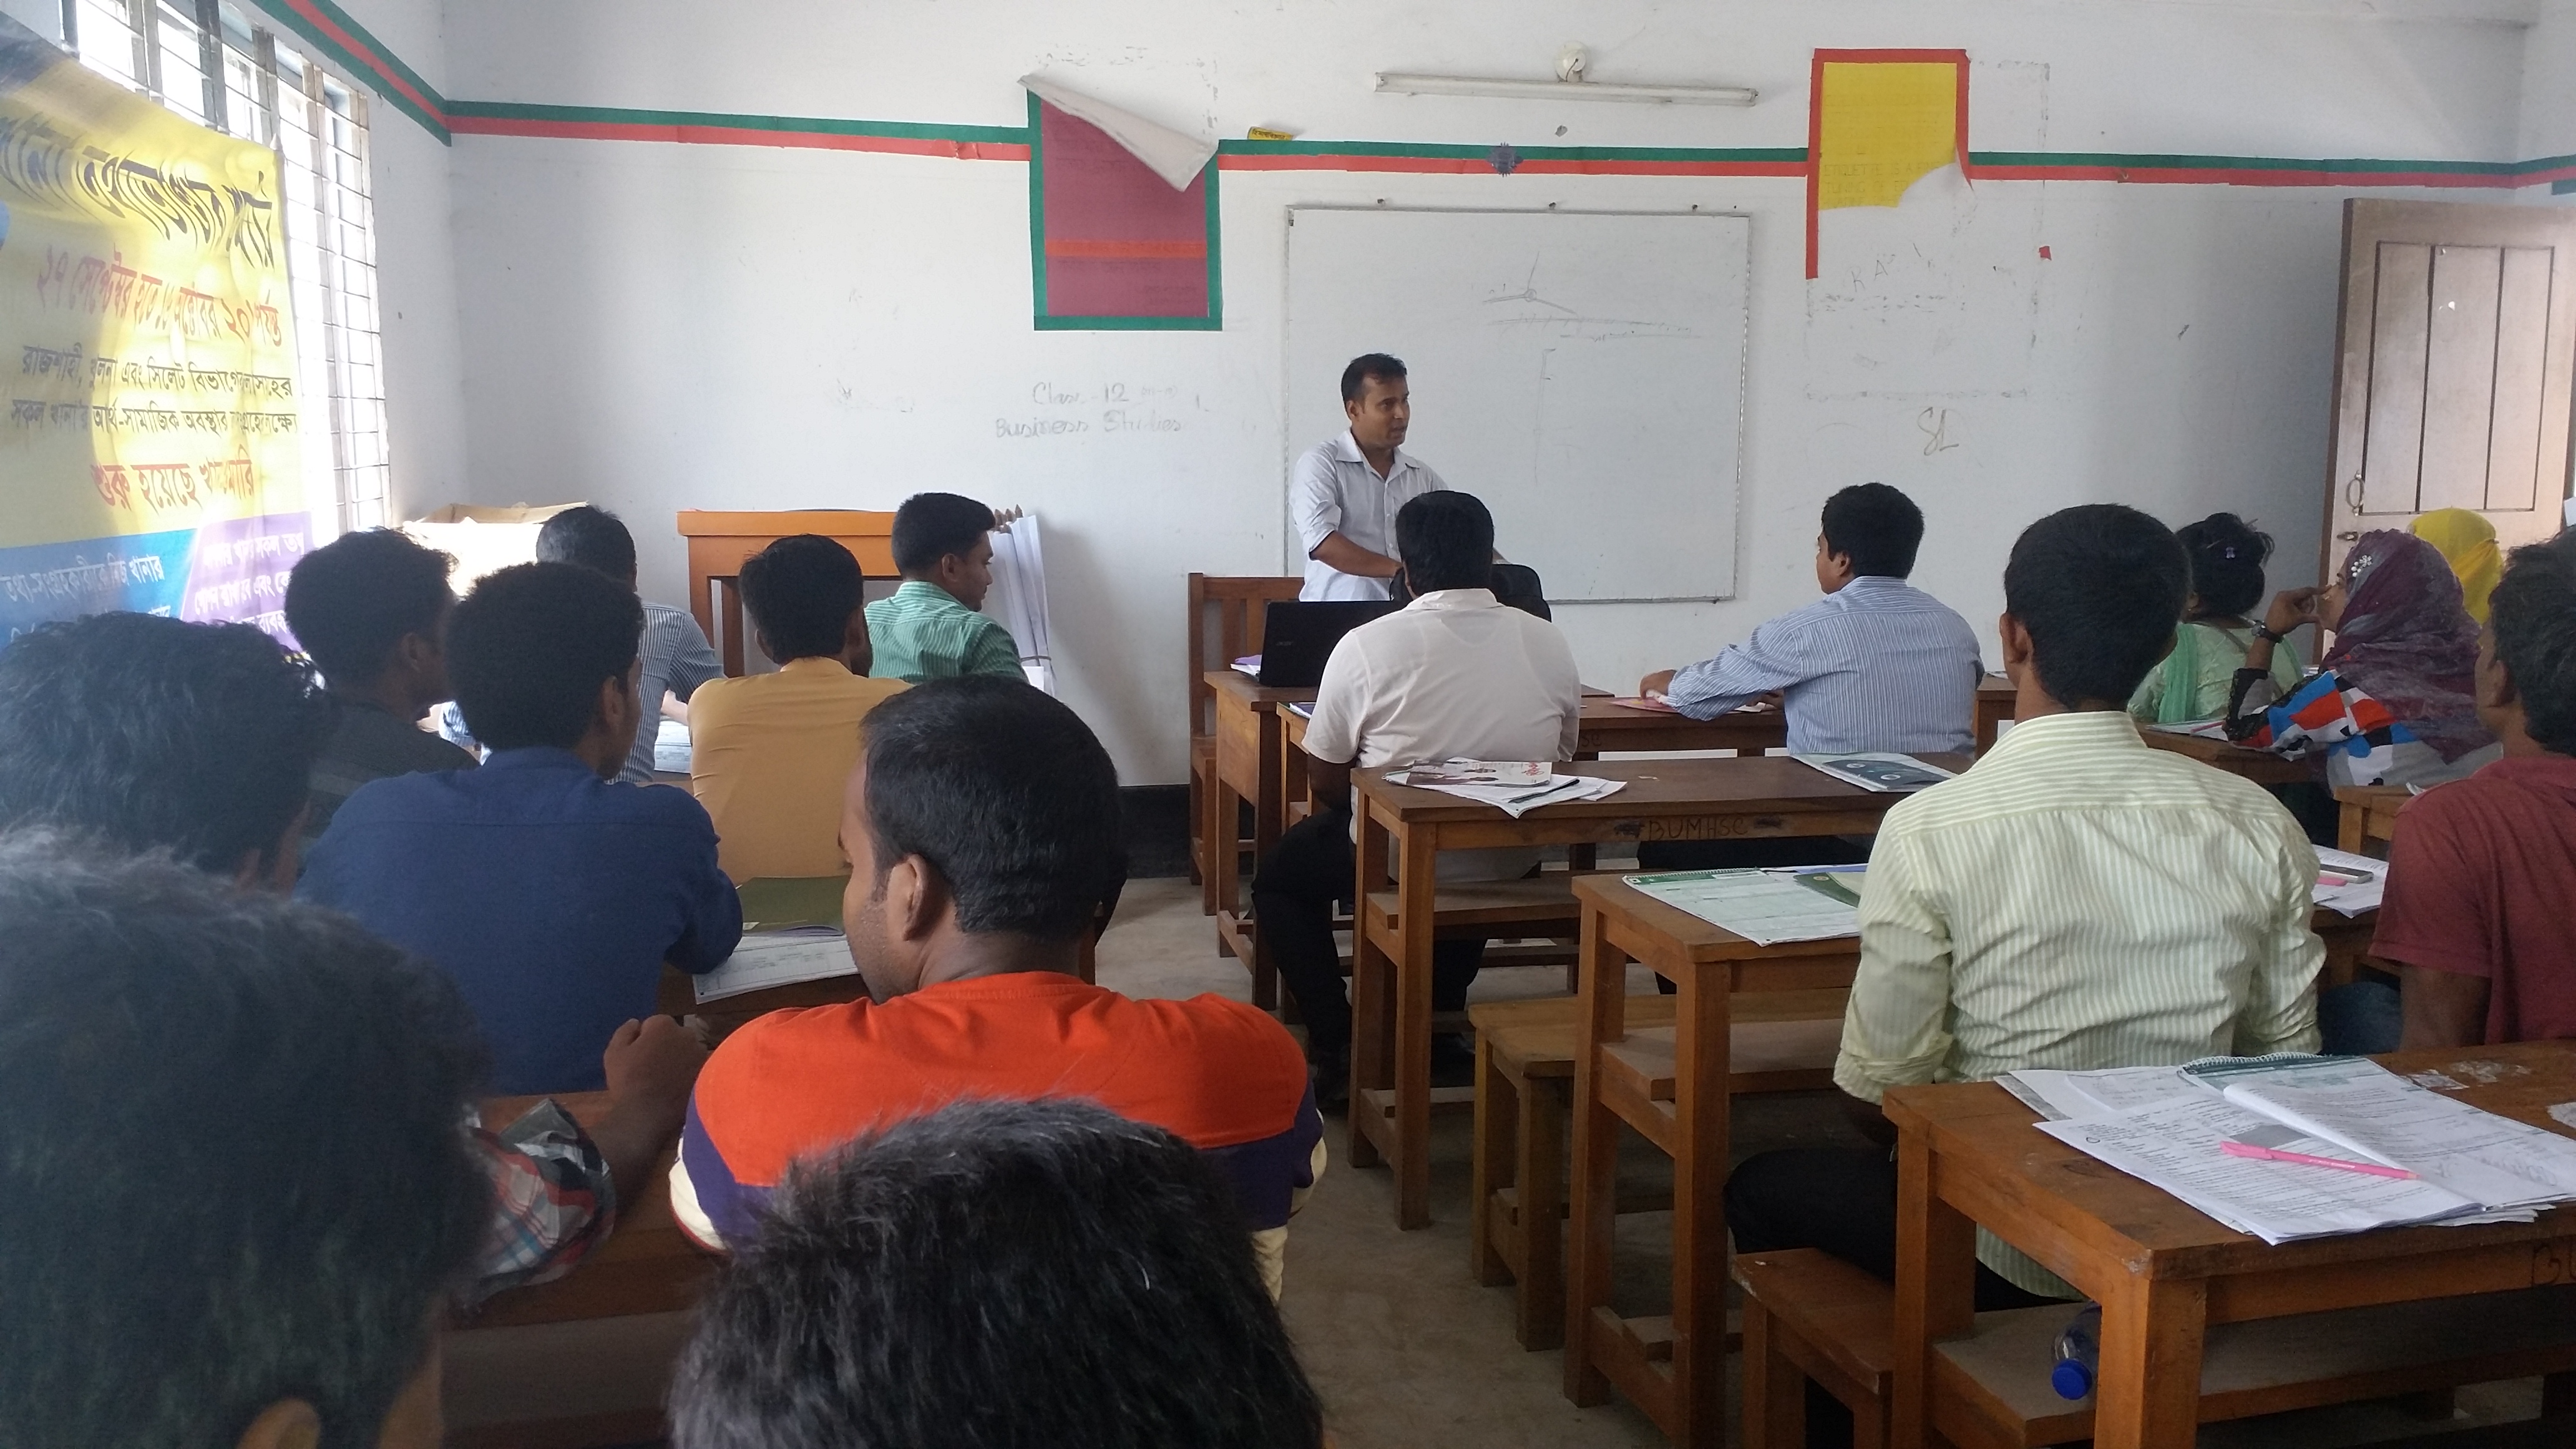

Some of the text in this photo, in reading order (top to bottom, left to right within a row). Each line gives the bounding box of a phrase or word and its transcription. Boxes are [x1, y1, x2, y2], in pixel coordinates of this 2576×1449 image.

[121, 362, 145, 391] এবং
[147, 355, 185, 392] সিলেট
[1104, 382, 1130, 403] 12
[995, 417, 1089, 438] Business
[130, 463, 203, 518] হয়েছে
[129, 554, 165, 583] খানার
[253, 575, 276, 598] এবং
[1648, 816, 1749, 841] BUMHSC
